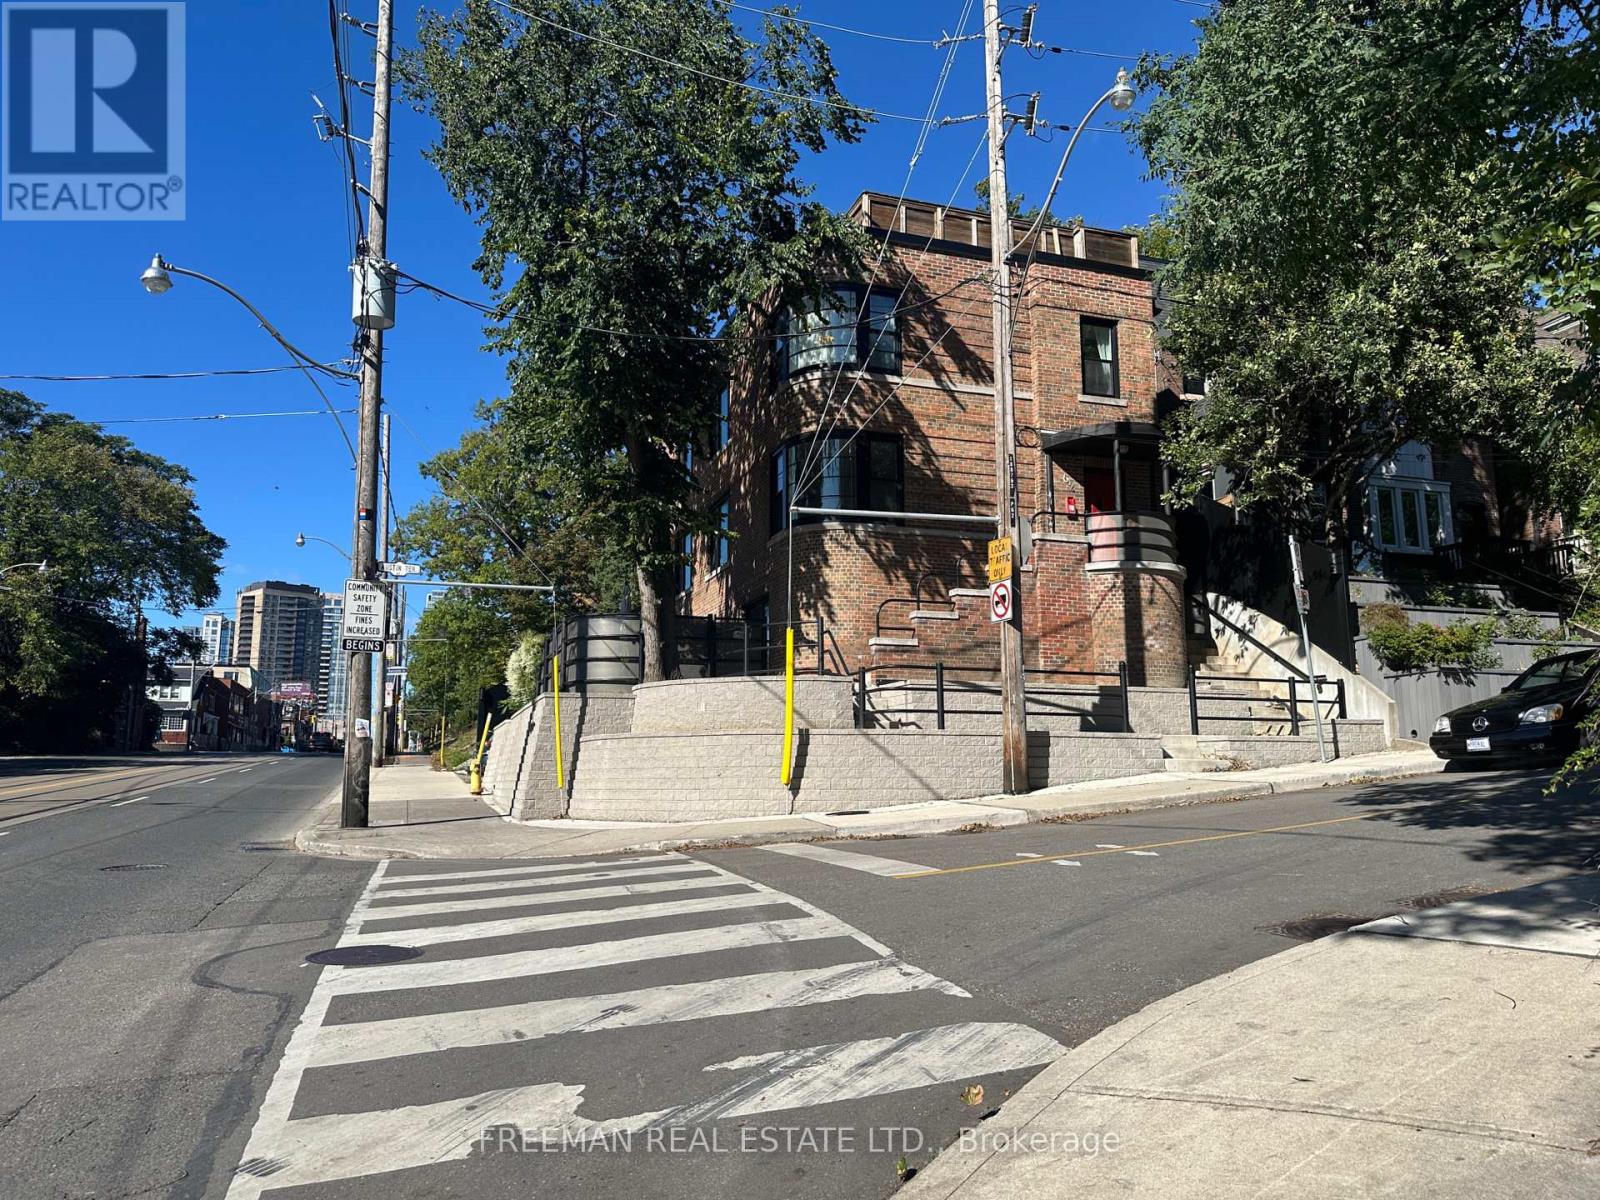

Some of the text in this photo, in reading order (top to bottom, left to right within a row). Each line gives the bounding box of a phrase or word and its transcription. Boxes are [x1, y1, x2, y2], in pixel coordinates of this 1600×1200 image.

[991, 543, 1008, 554] LOCA
[348, 582, 383, 592] COMMUNITY
[353, 594, 377, 603] SAFETY
[356, 605, 373, 613] ZONE
[346, 626, 380, 635] INCREASED
[346, 641, 380, 651] BEGINS
